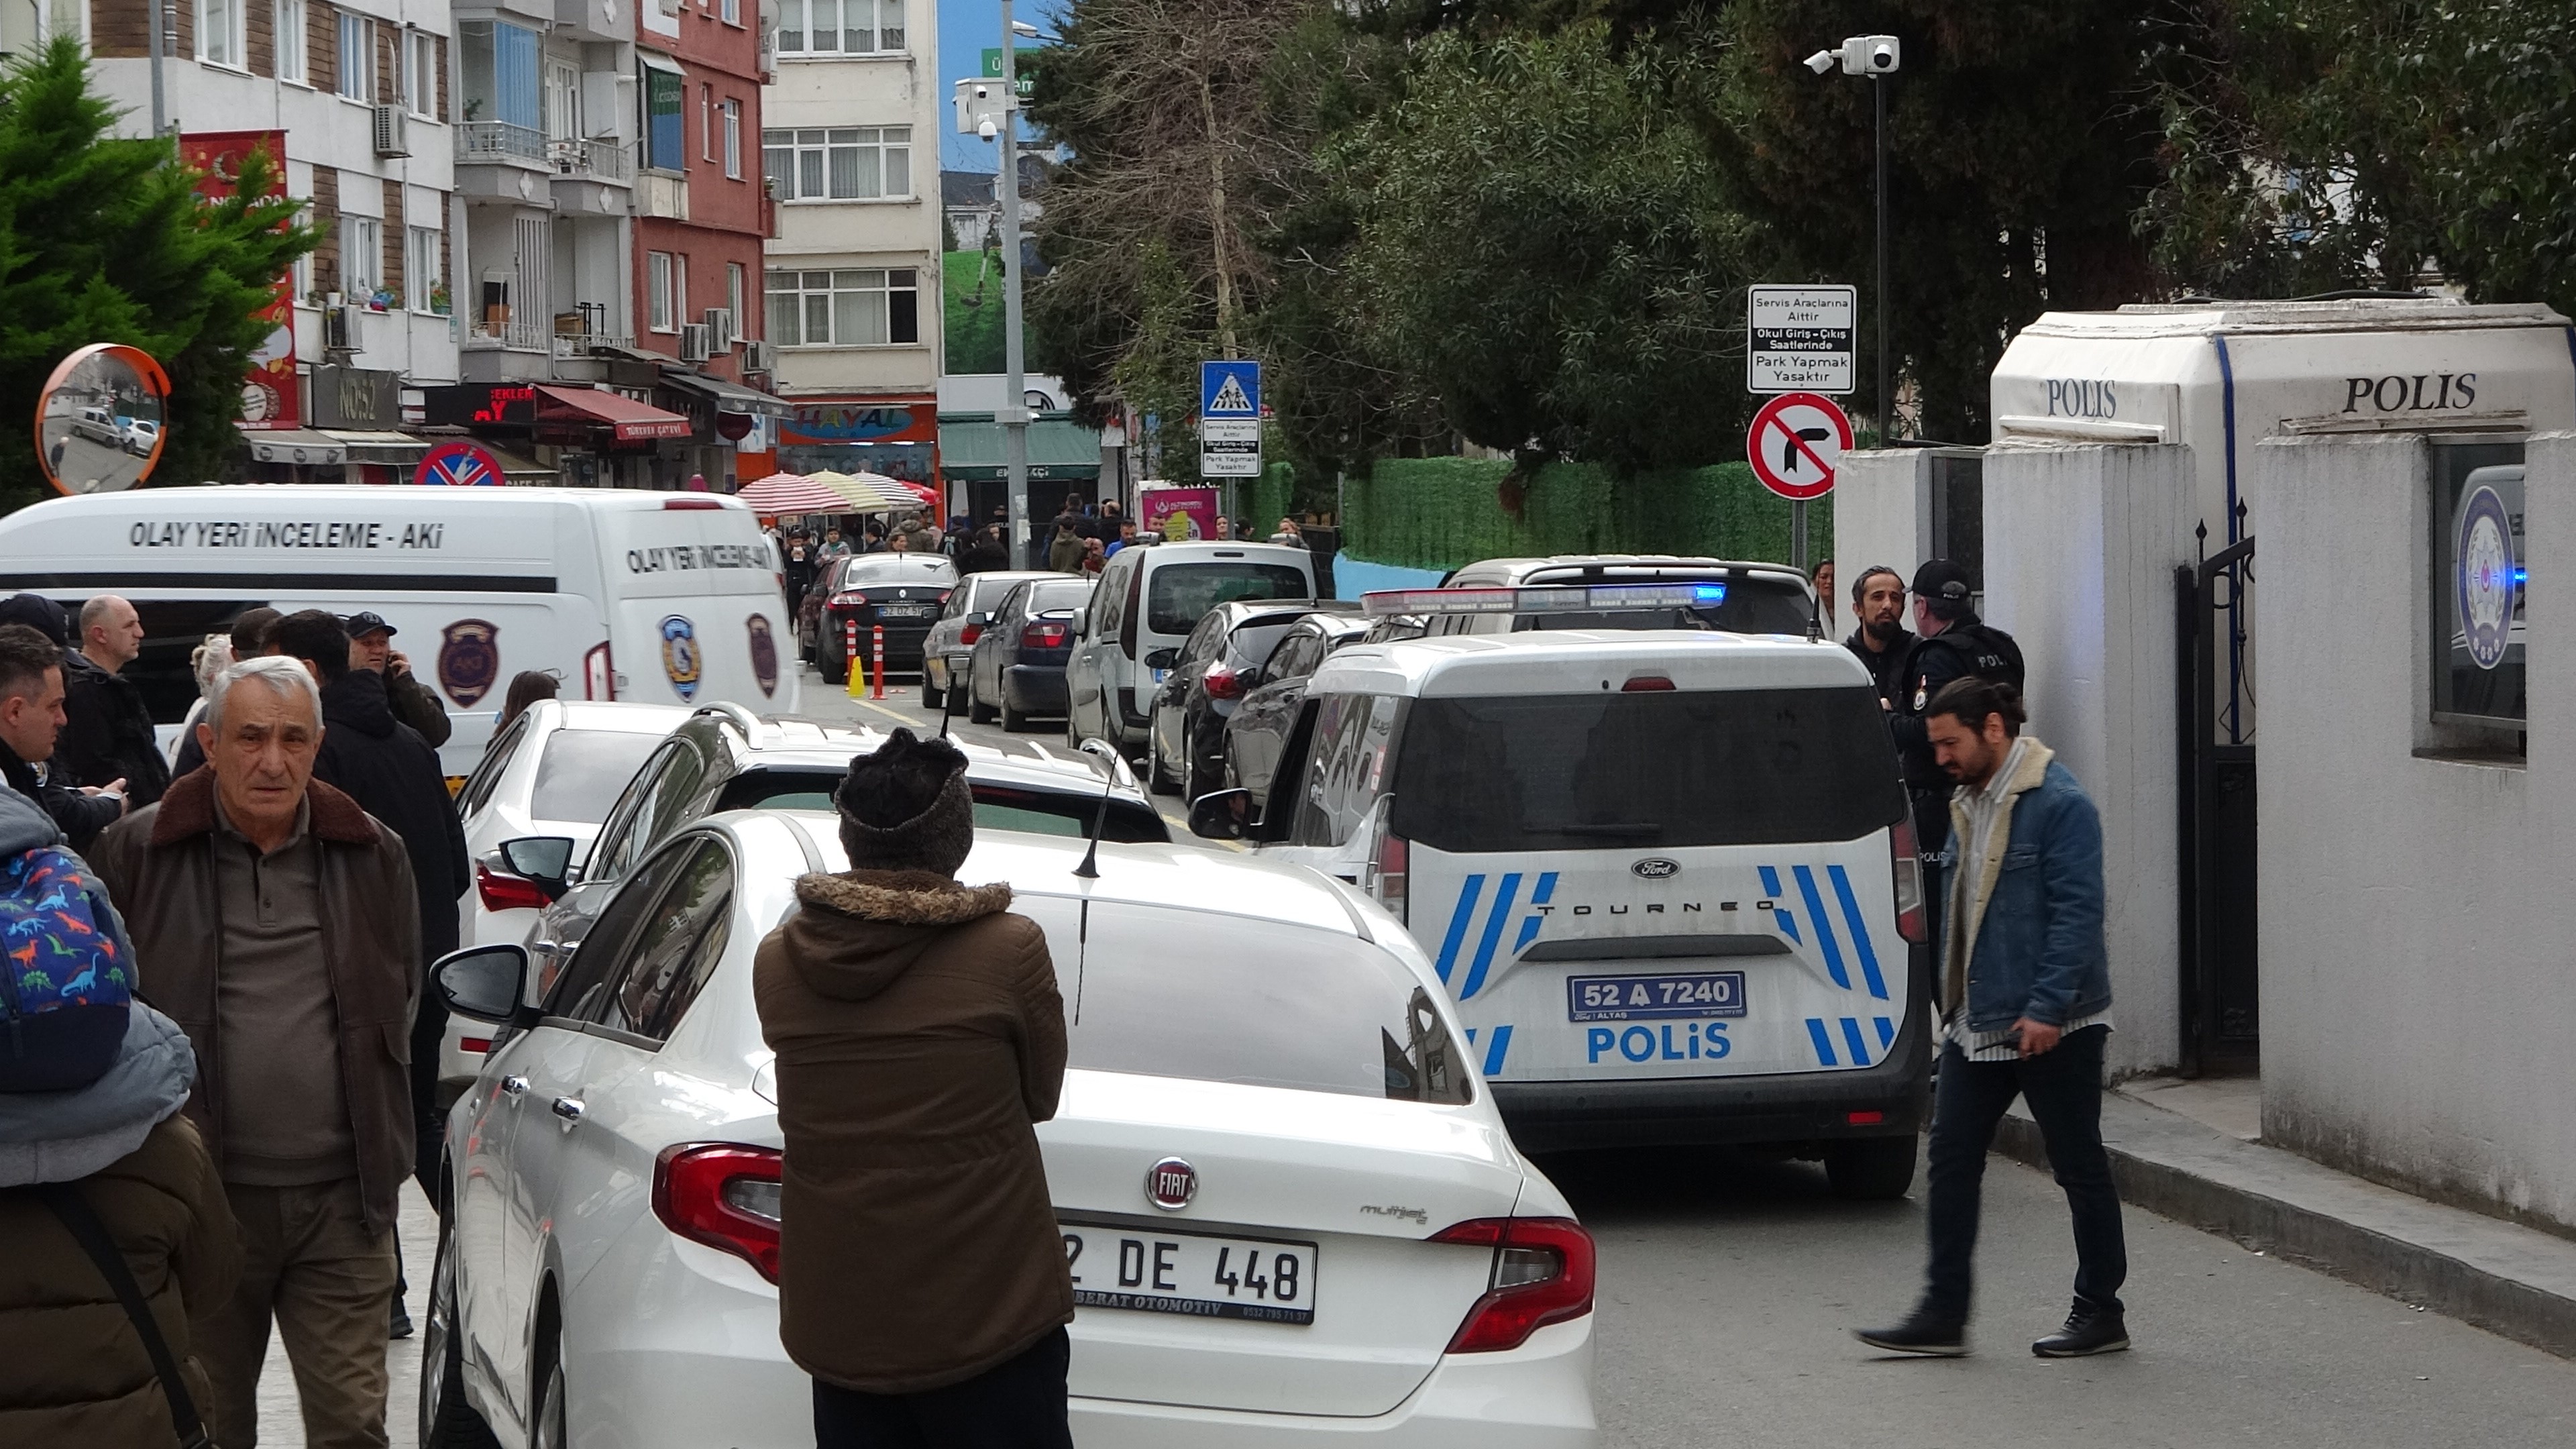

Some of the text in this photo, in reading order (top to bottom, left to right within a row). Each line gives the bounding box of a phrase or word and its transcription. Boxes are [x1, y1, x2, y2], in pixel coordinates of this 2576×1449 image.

[1756, 298, 1848, 309] Servis Araçlarına
[1787, 311, 1819, 321] Aittir
[1757, 329, 1782, 338] Okul
[1770, 340, 1833, 350] Saatlerinde
[1756, 356, 1848, 370] Park Yapmak
[1774, 370, 1830, 381] Yasaktır
[2047, 378, 2116, 419] POLIS
[2342, 373, 2476, 413] POLIS
[796, 408, 902, 430] HAYAL
[130, 522, 193, 547] OLAY
[1978, 654, 2008, 668] POL
[1641, 861, 1672, 875] Ford
[1537, 900, 1774, 916] TOURNEO
[1584, 980, 1731, 1007] 52 A 7240
[1159, 1172, 1189, 1197] FIAT
[1118, 1238, 1179, 1291] DE
[1214, 1246, 1299, 1301] 448
[1074, 1290, 1131, 1308] BERAT
